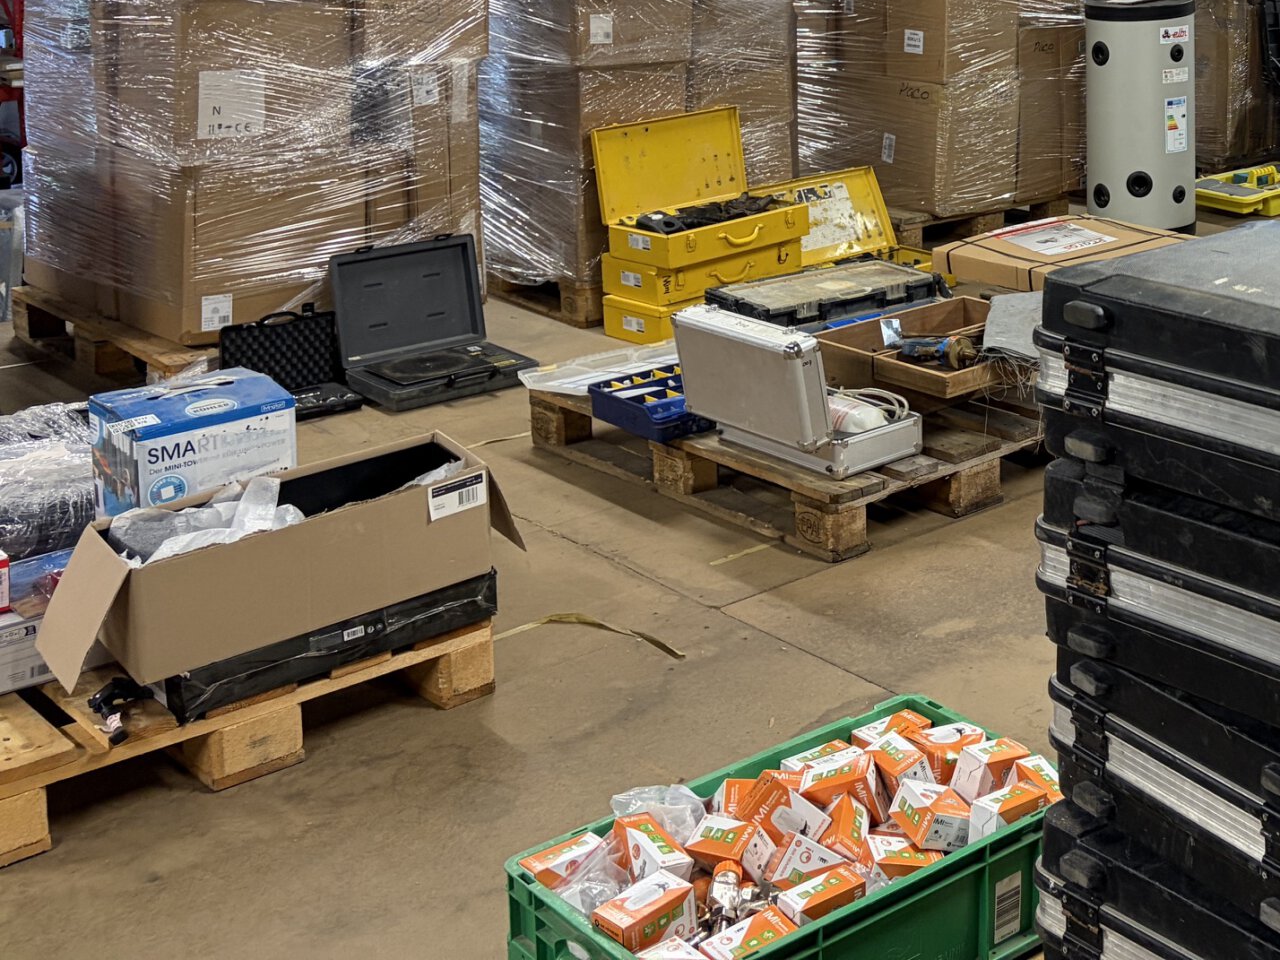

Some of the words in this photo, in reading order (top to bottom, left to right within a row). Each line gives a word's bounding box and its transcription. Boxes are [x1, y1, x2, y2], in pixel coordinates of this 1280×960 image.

[855, 782, 867, 798] IMI
[751, 804, 770, 827] IMI
[922, 812, 932, 828] IMI
[741, 825, 753, 841] IMI
[763, 909, 781, 925] IMI
